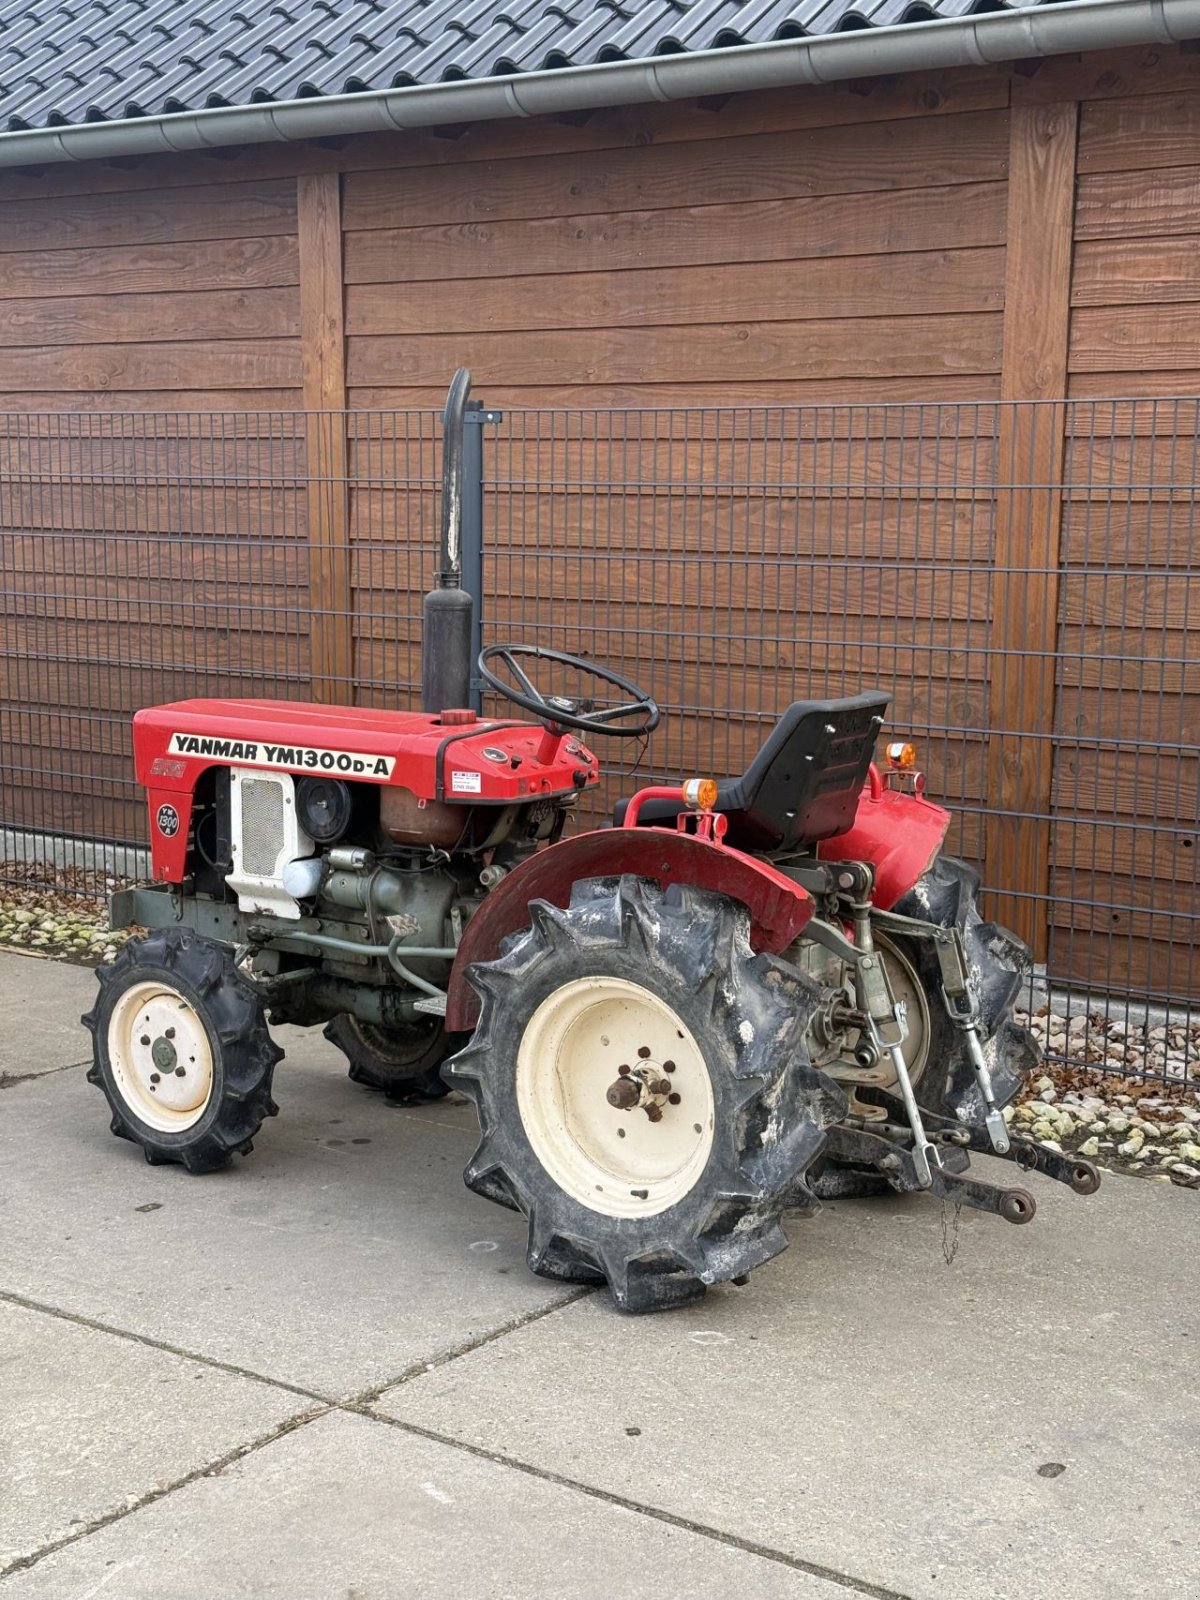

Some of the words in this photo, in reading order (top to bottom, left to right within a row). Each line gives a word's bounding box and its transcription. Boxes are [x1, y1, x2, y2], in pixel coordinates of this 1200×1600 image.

[175, 735, 258, 760] YANMAR
[162, 807, 173, 815] YM
[159, 815, 177, 828] 1300
